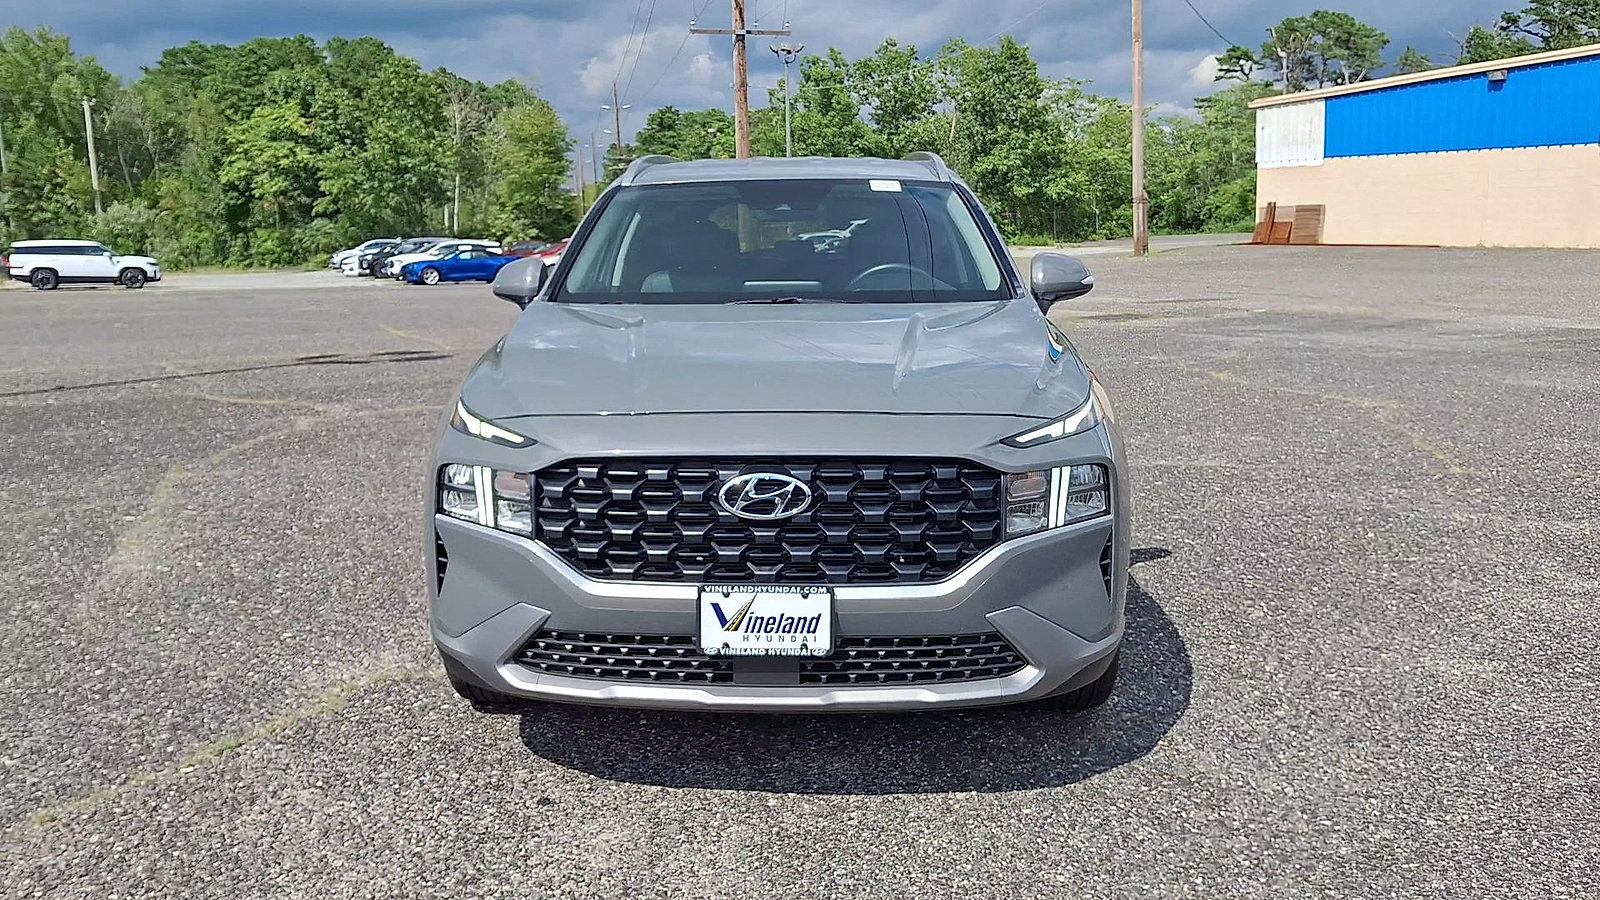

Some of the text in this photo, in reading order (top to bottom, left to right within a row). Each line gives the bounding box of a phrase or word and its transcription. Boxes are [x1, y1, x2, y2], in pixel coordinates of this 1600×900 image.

[704, 585, 828, 594] VINELANDHYUNDAI.COM
[710, 592, 822, 634] Vineland
[742, 635, 817, 643] HYUNDAI
[719, 648, 812, 656] VINELAND HYUNDAI
